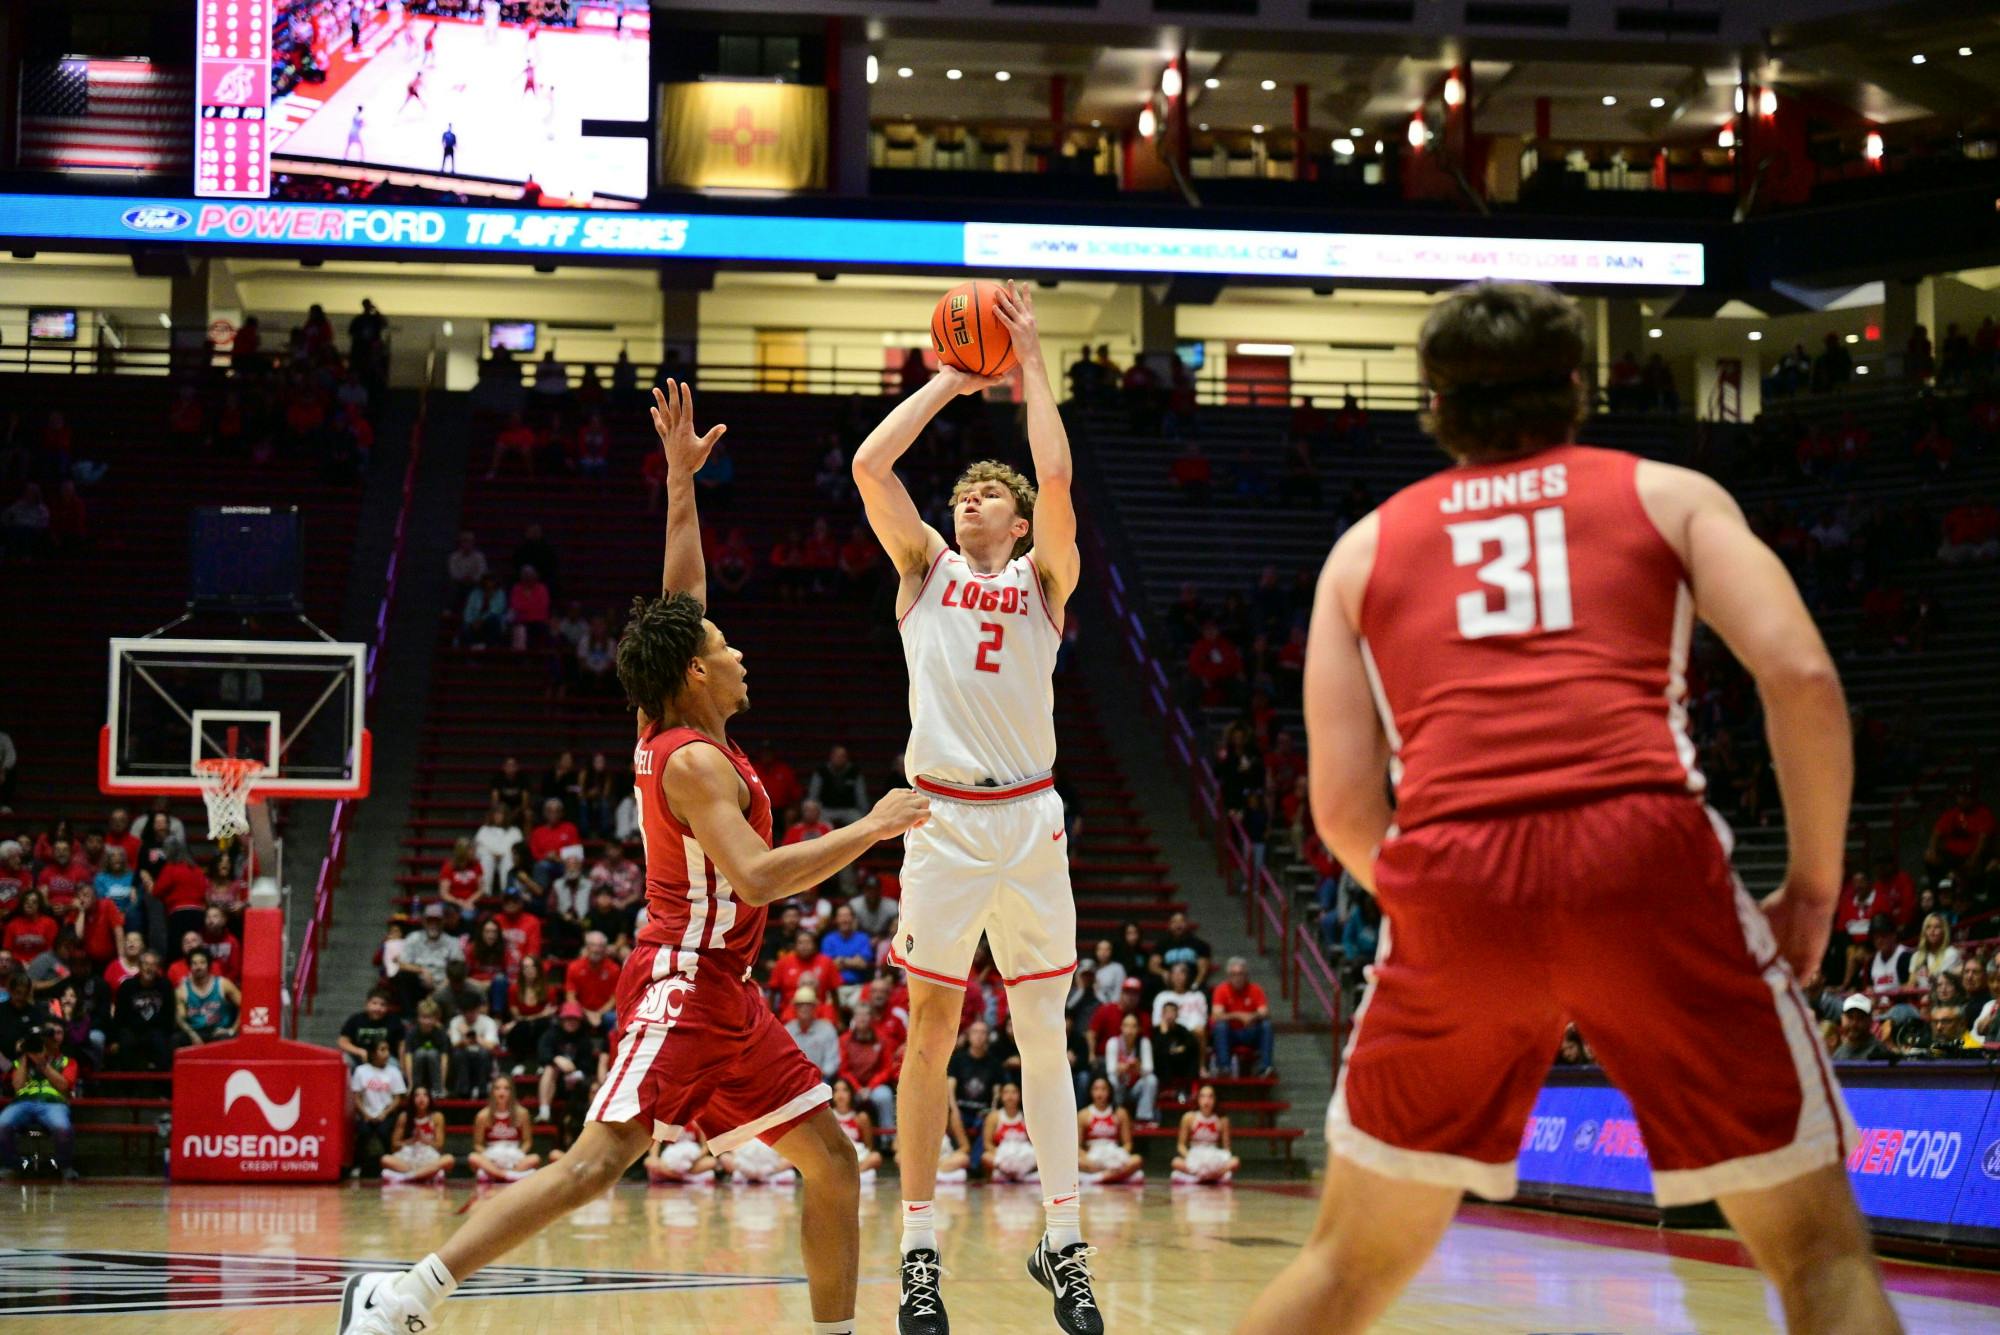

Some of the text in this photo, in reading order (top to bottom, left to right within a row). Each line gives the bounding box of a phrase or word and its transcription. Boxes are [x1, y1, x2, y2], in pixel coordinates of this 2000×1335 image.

[196, 204, 446, 243] POWERFORD
[466, 213, 580, 247] TIP-OFF
[581, 217, 689, 250] SERIES
[1605, 254, 1645, 269] PAIN
[1439, 463, 1568, 514] JONES
[1442, 505, 1574, 641] 31
[941, 580, 1029, 617] LOBOS
[974, 621, 1004, 674] 2
[182, 1134, 320, 1158] NUSENDA
[239, 1160, 319, 1172] CREDIT UNION
